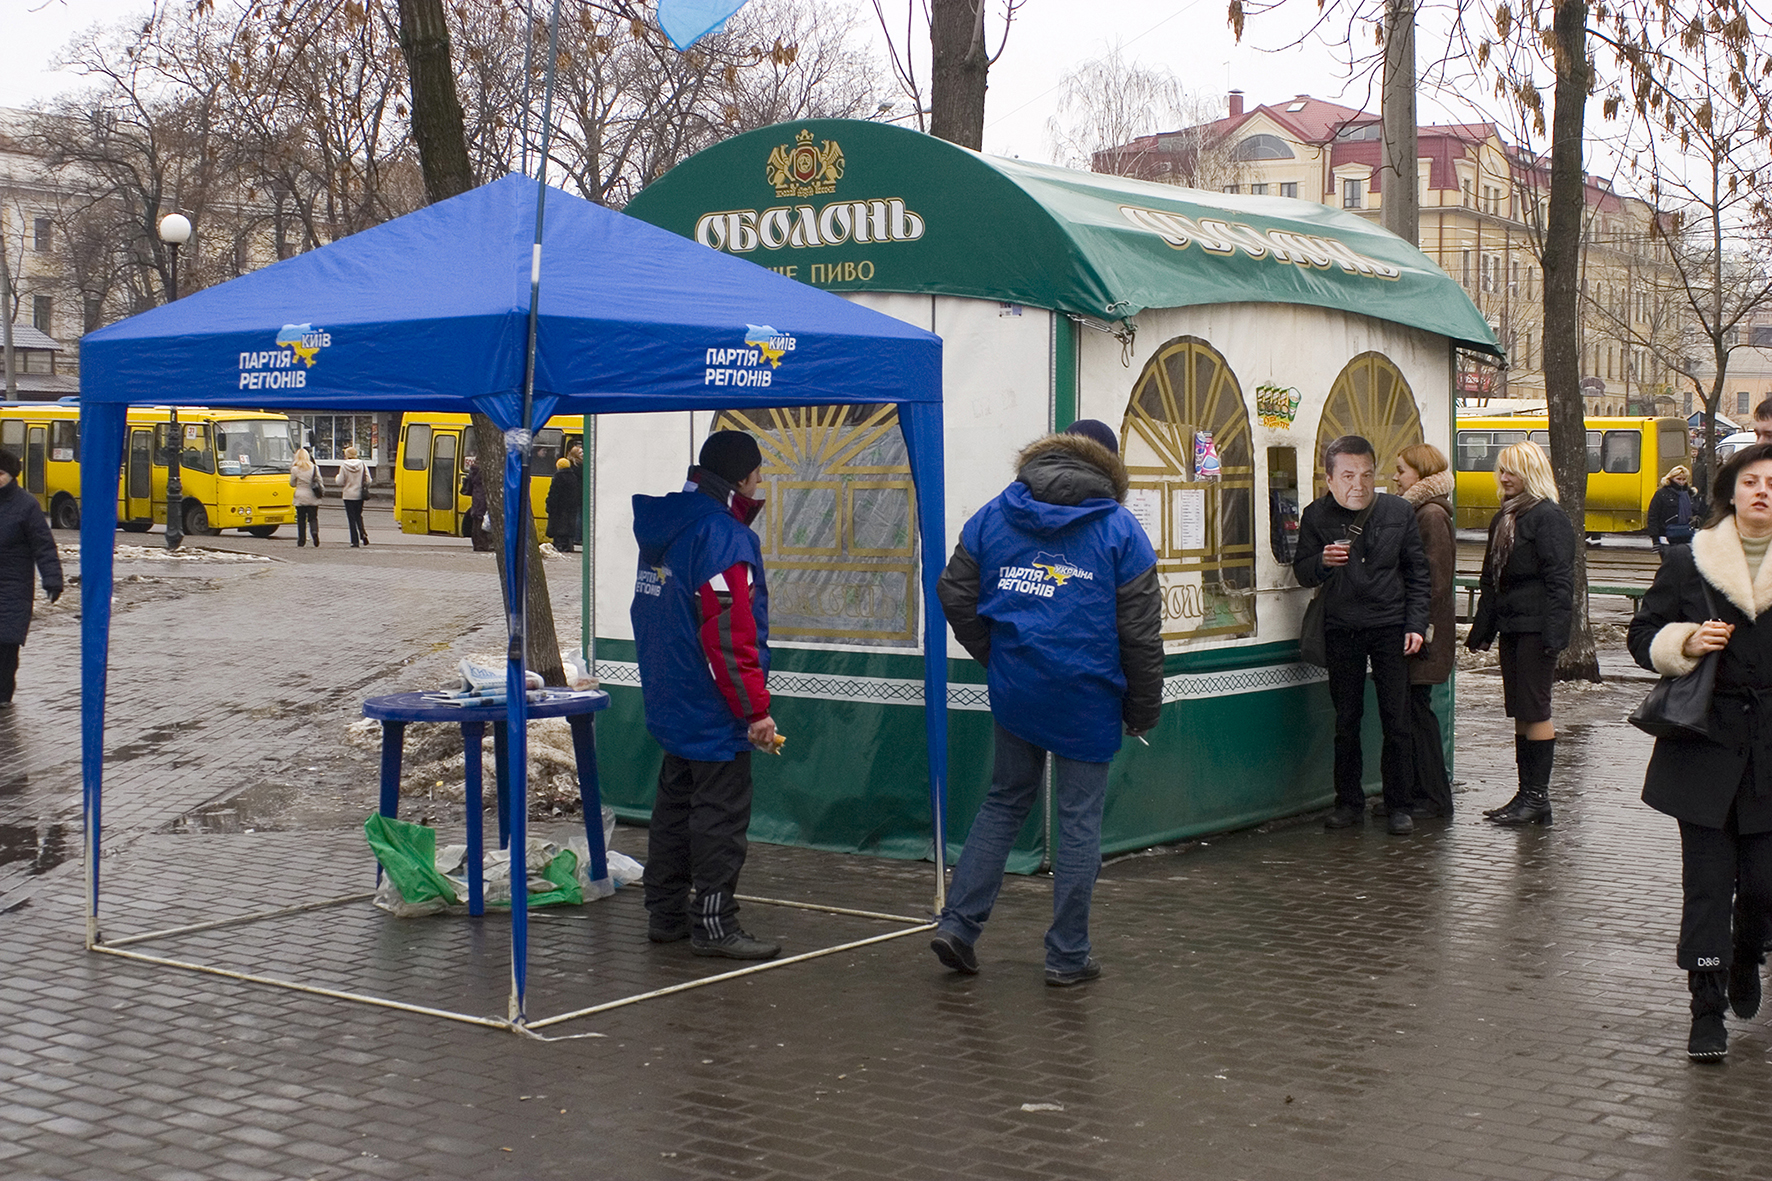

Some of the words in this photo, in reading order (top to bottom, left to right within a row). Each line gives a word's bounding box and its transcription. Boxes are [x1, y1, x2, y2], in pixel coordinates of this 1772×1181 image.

[811, 260, 875, 284] ПИВО
[302, 328, 332, 348] КИЇВ
[768, 332, 797, 351] КИЇВ
[239, 350, 291, 369] ПАРТІЯ
[705, 348, 759, 367] ПАРТІЯ
[239, 370, 307, 390] РЕГІОНІВ
[704, 368, 772, 387] РЕГІОНІВ
[1000, 567, 1044, 582] ПАРТІЯ
[1054, 563, 1094, 580] УКРАЇНА
[998, 578, 1055, 598] РЕГІОНІВ
[1697, 956, 1720, 967] D&G
